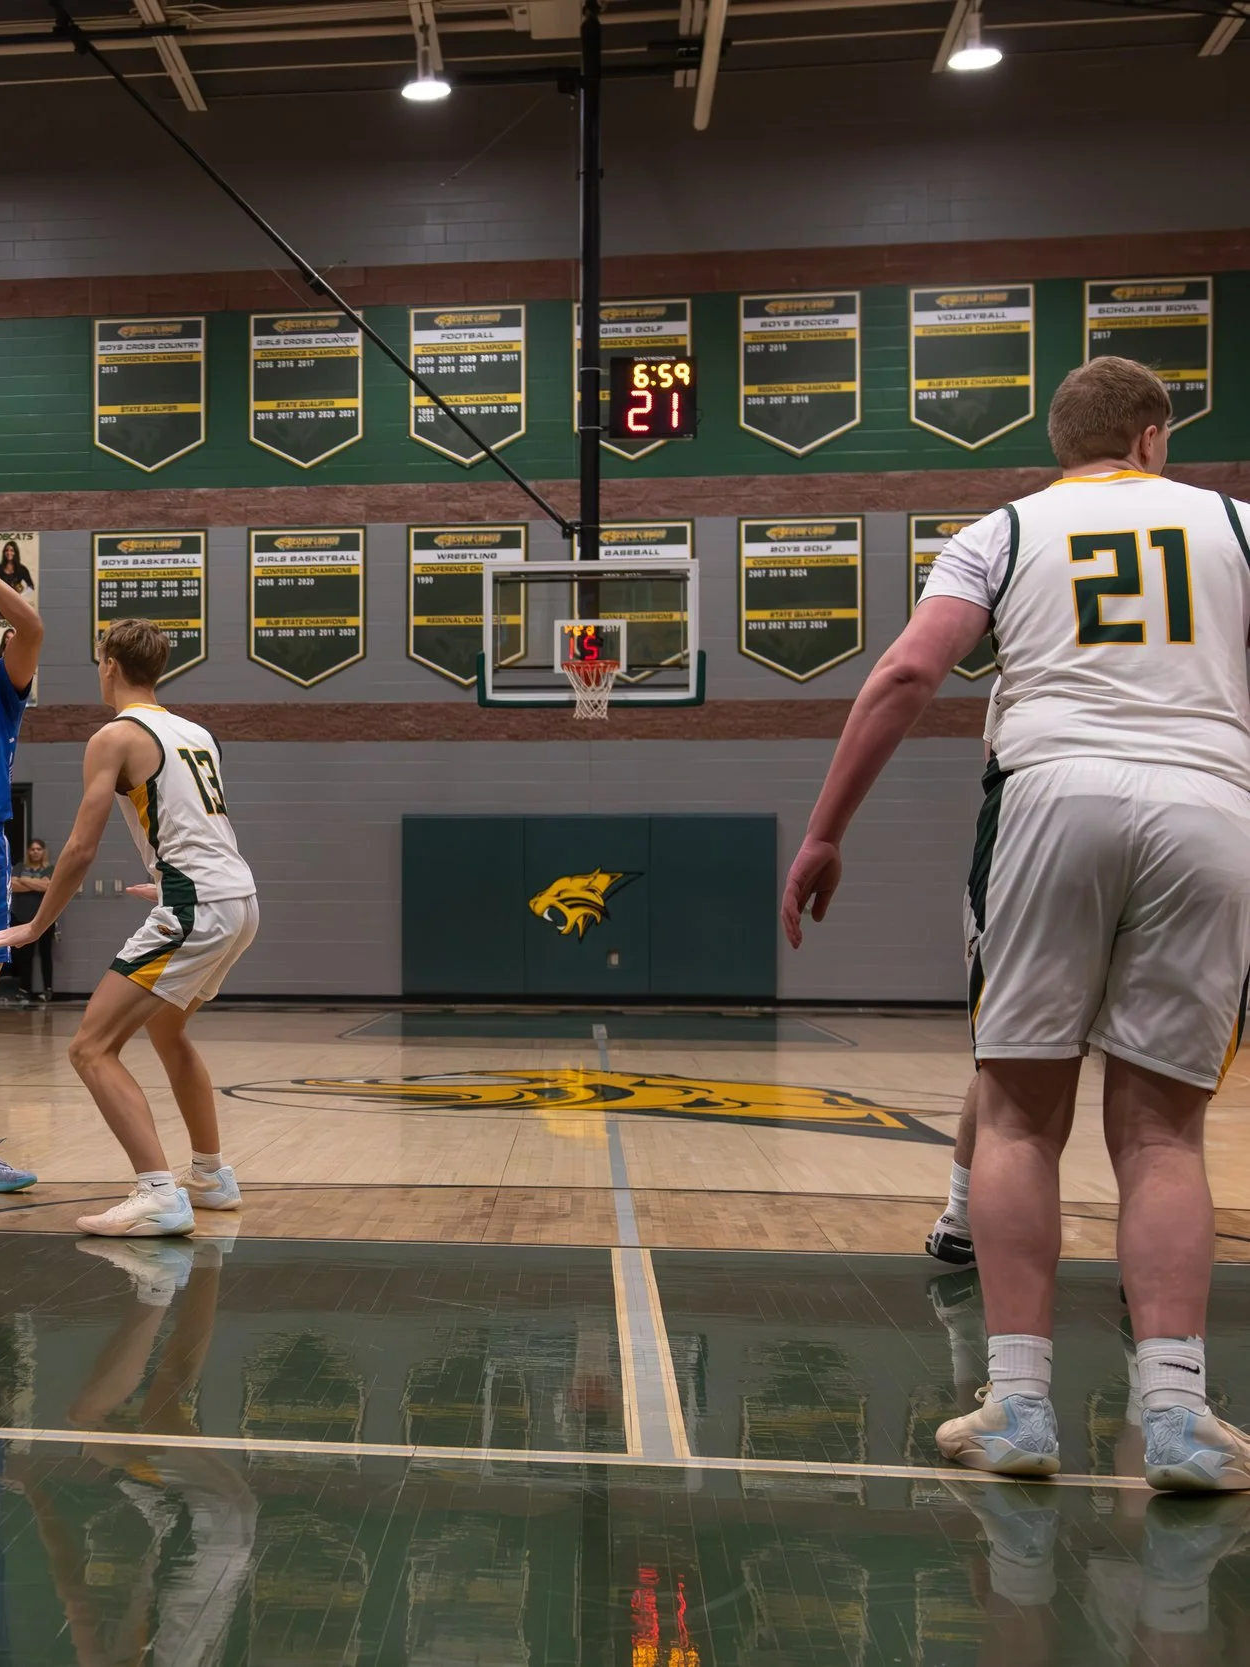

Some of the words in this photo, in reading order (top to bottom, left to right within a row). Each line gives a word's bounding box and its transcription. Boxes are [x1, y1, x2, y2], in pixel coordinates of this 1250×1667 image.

[938, 312, 1007, 320] VOLLEYBALL
[634, 363, 690, 388] 6:59
[628, 390, 678, 431] 21
[1067, 526, 1194, 648] 21
[176, 747, 227, 816] 13
